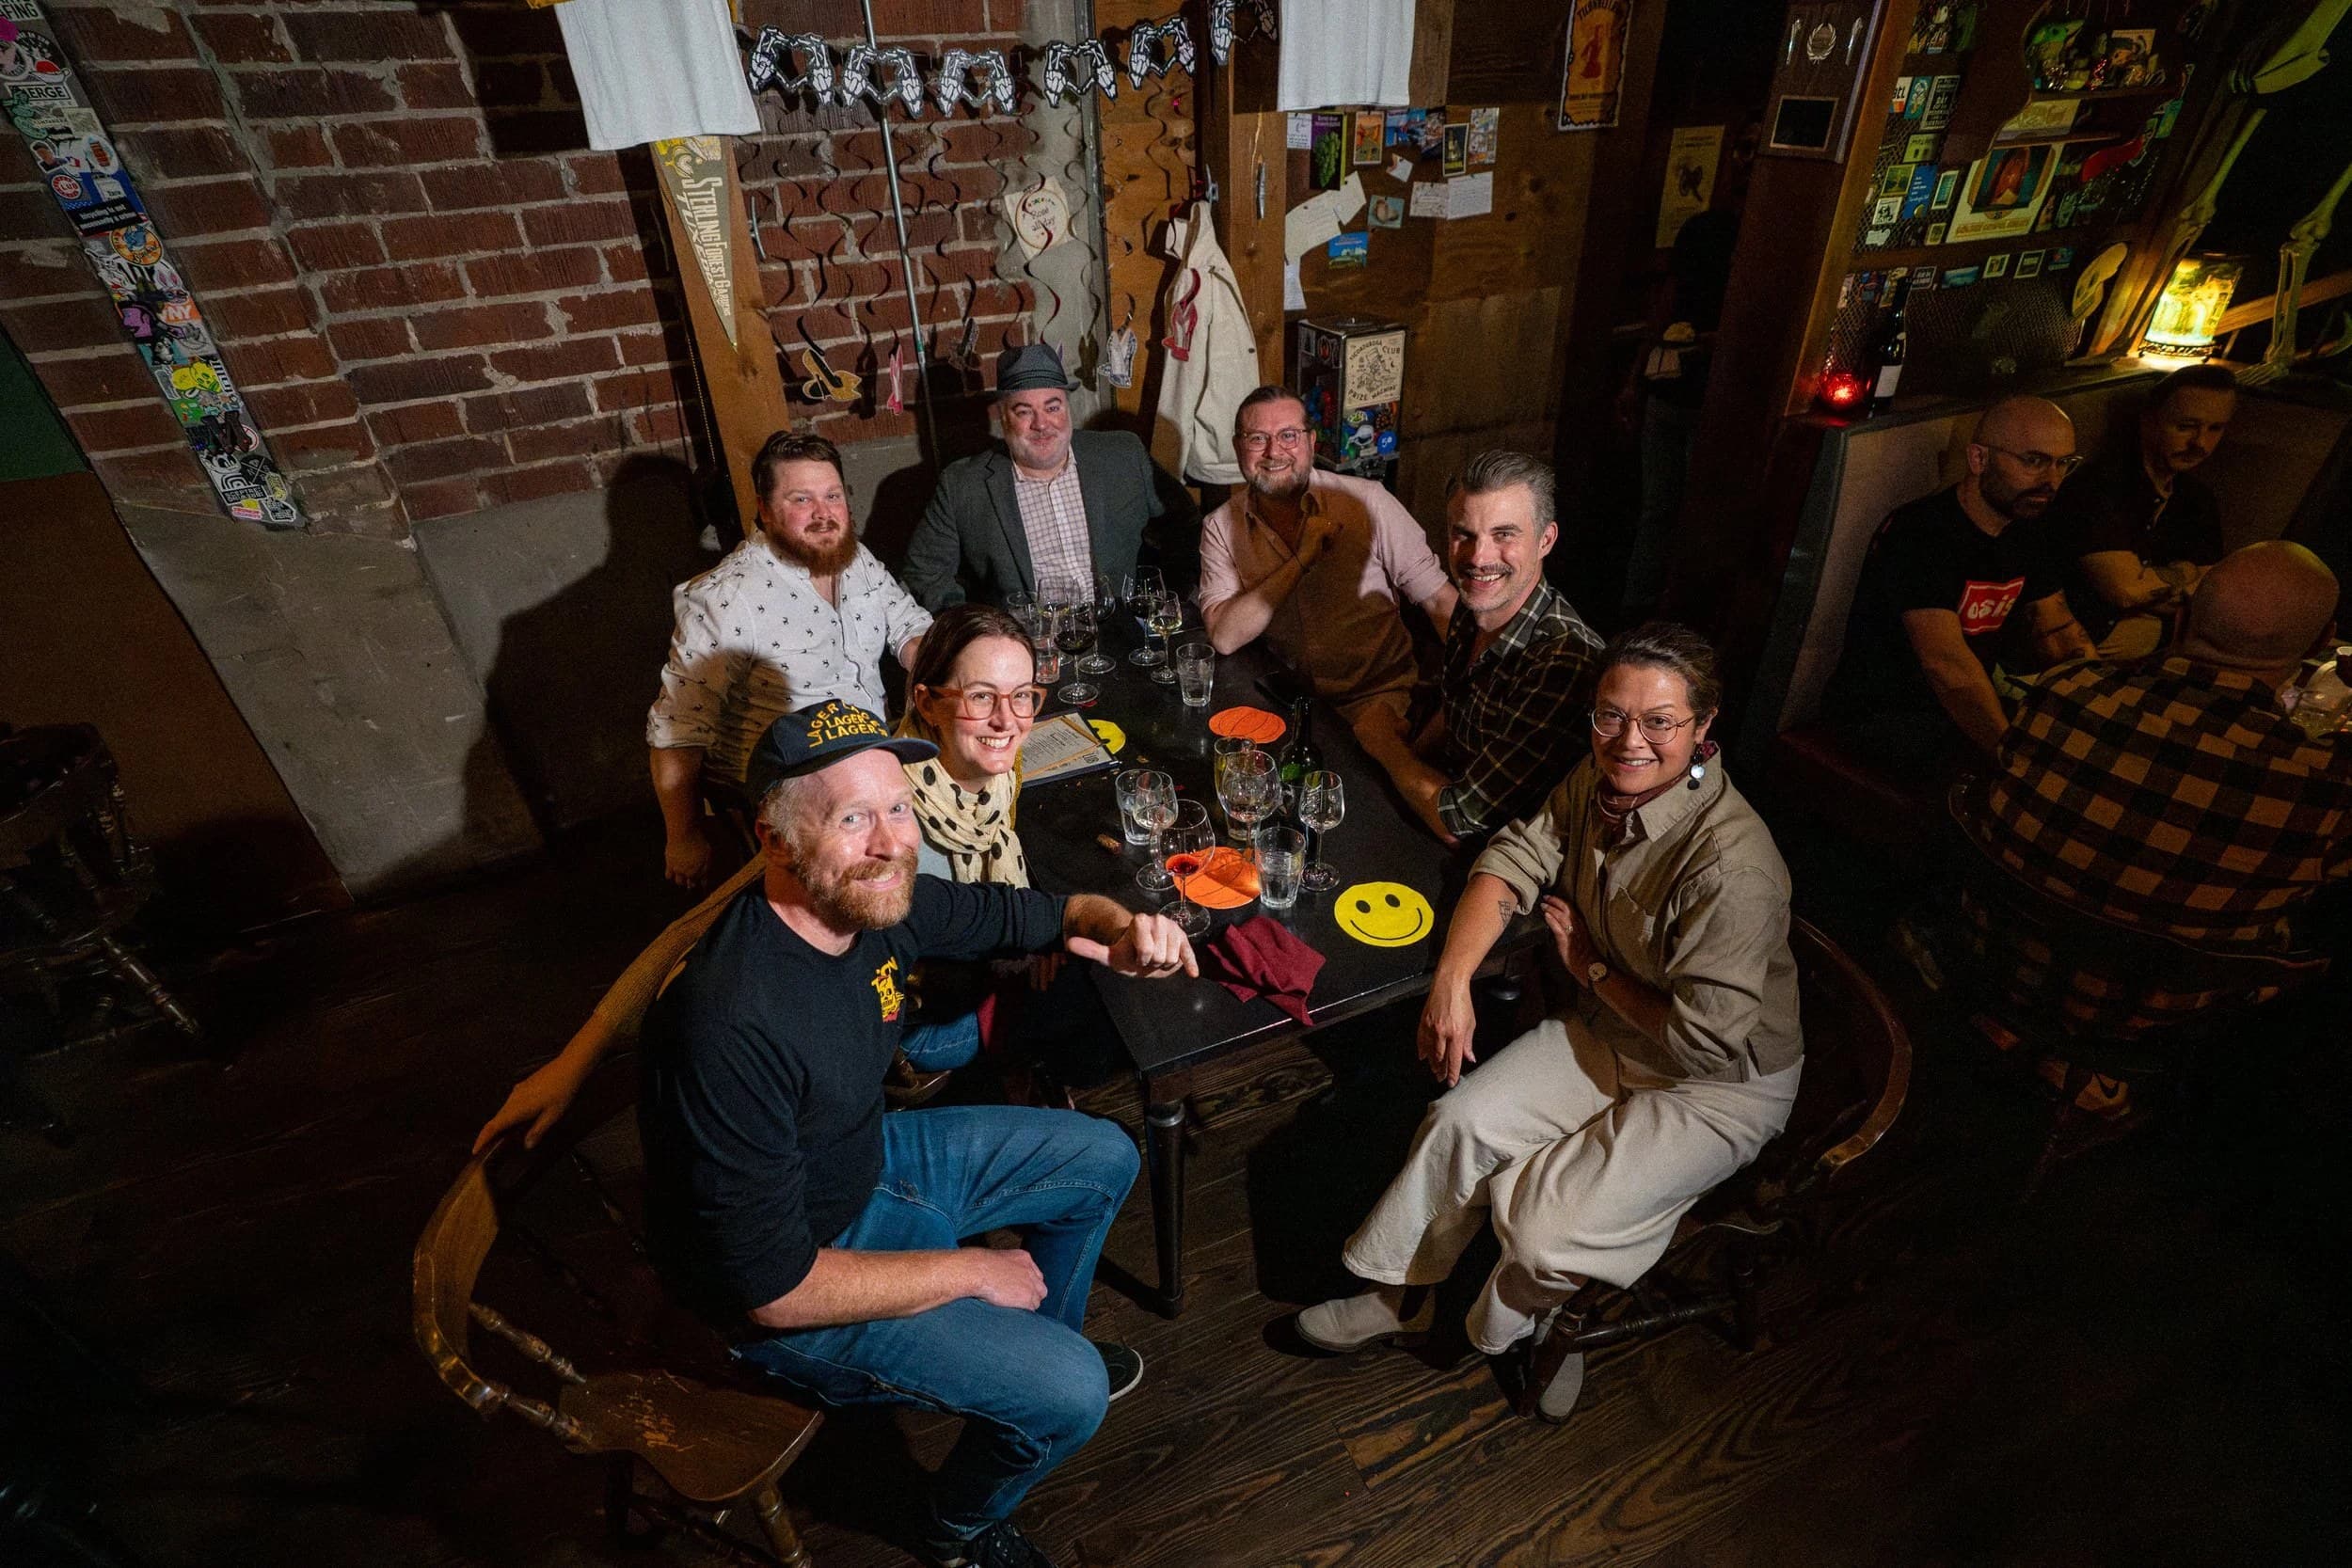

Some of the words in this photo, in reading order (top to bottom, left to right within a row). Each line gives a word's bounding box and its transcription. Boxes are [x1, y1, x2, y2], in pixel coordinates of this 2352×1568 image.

[682, 176, 723, 245] STERLING
[704, 241, 728, 280] FOREST
[1381, 344, 1401, 356] CLUB
[806, 700, 840, 749] LAGER
[824, 713, 866, 729] LAGER
[824, 723, 878, 741] LAGER
